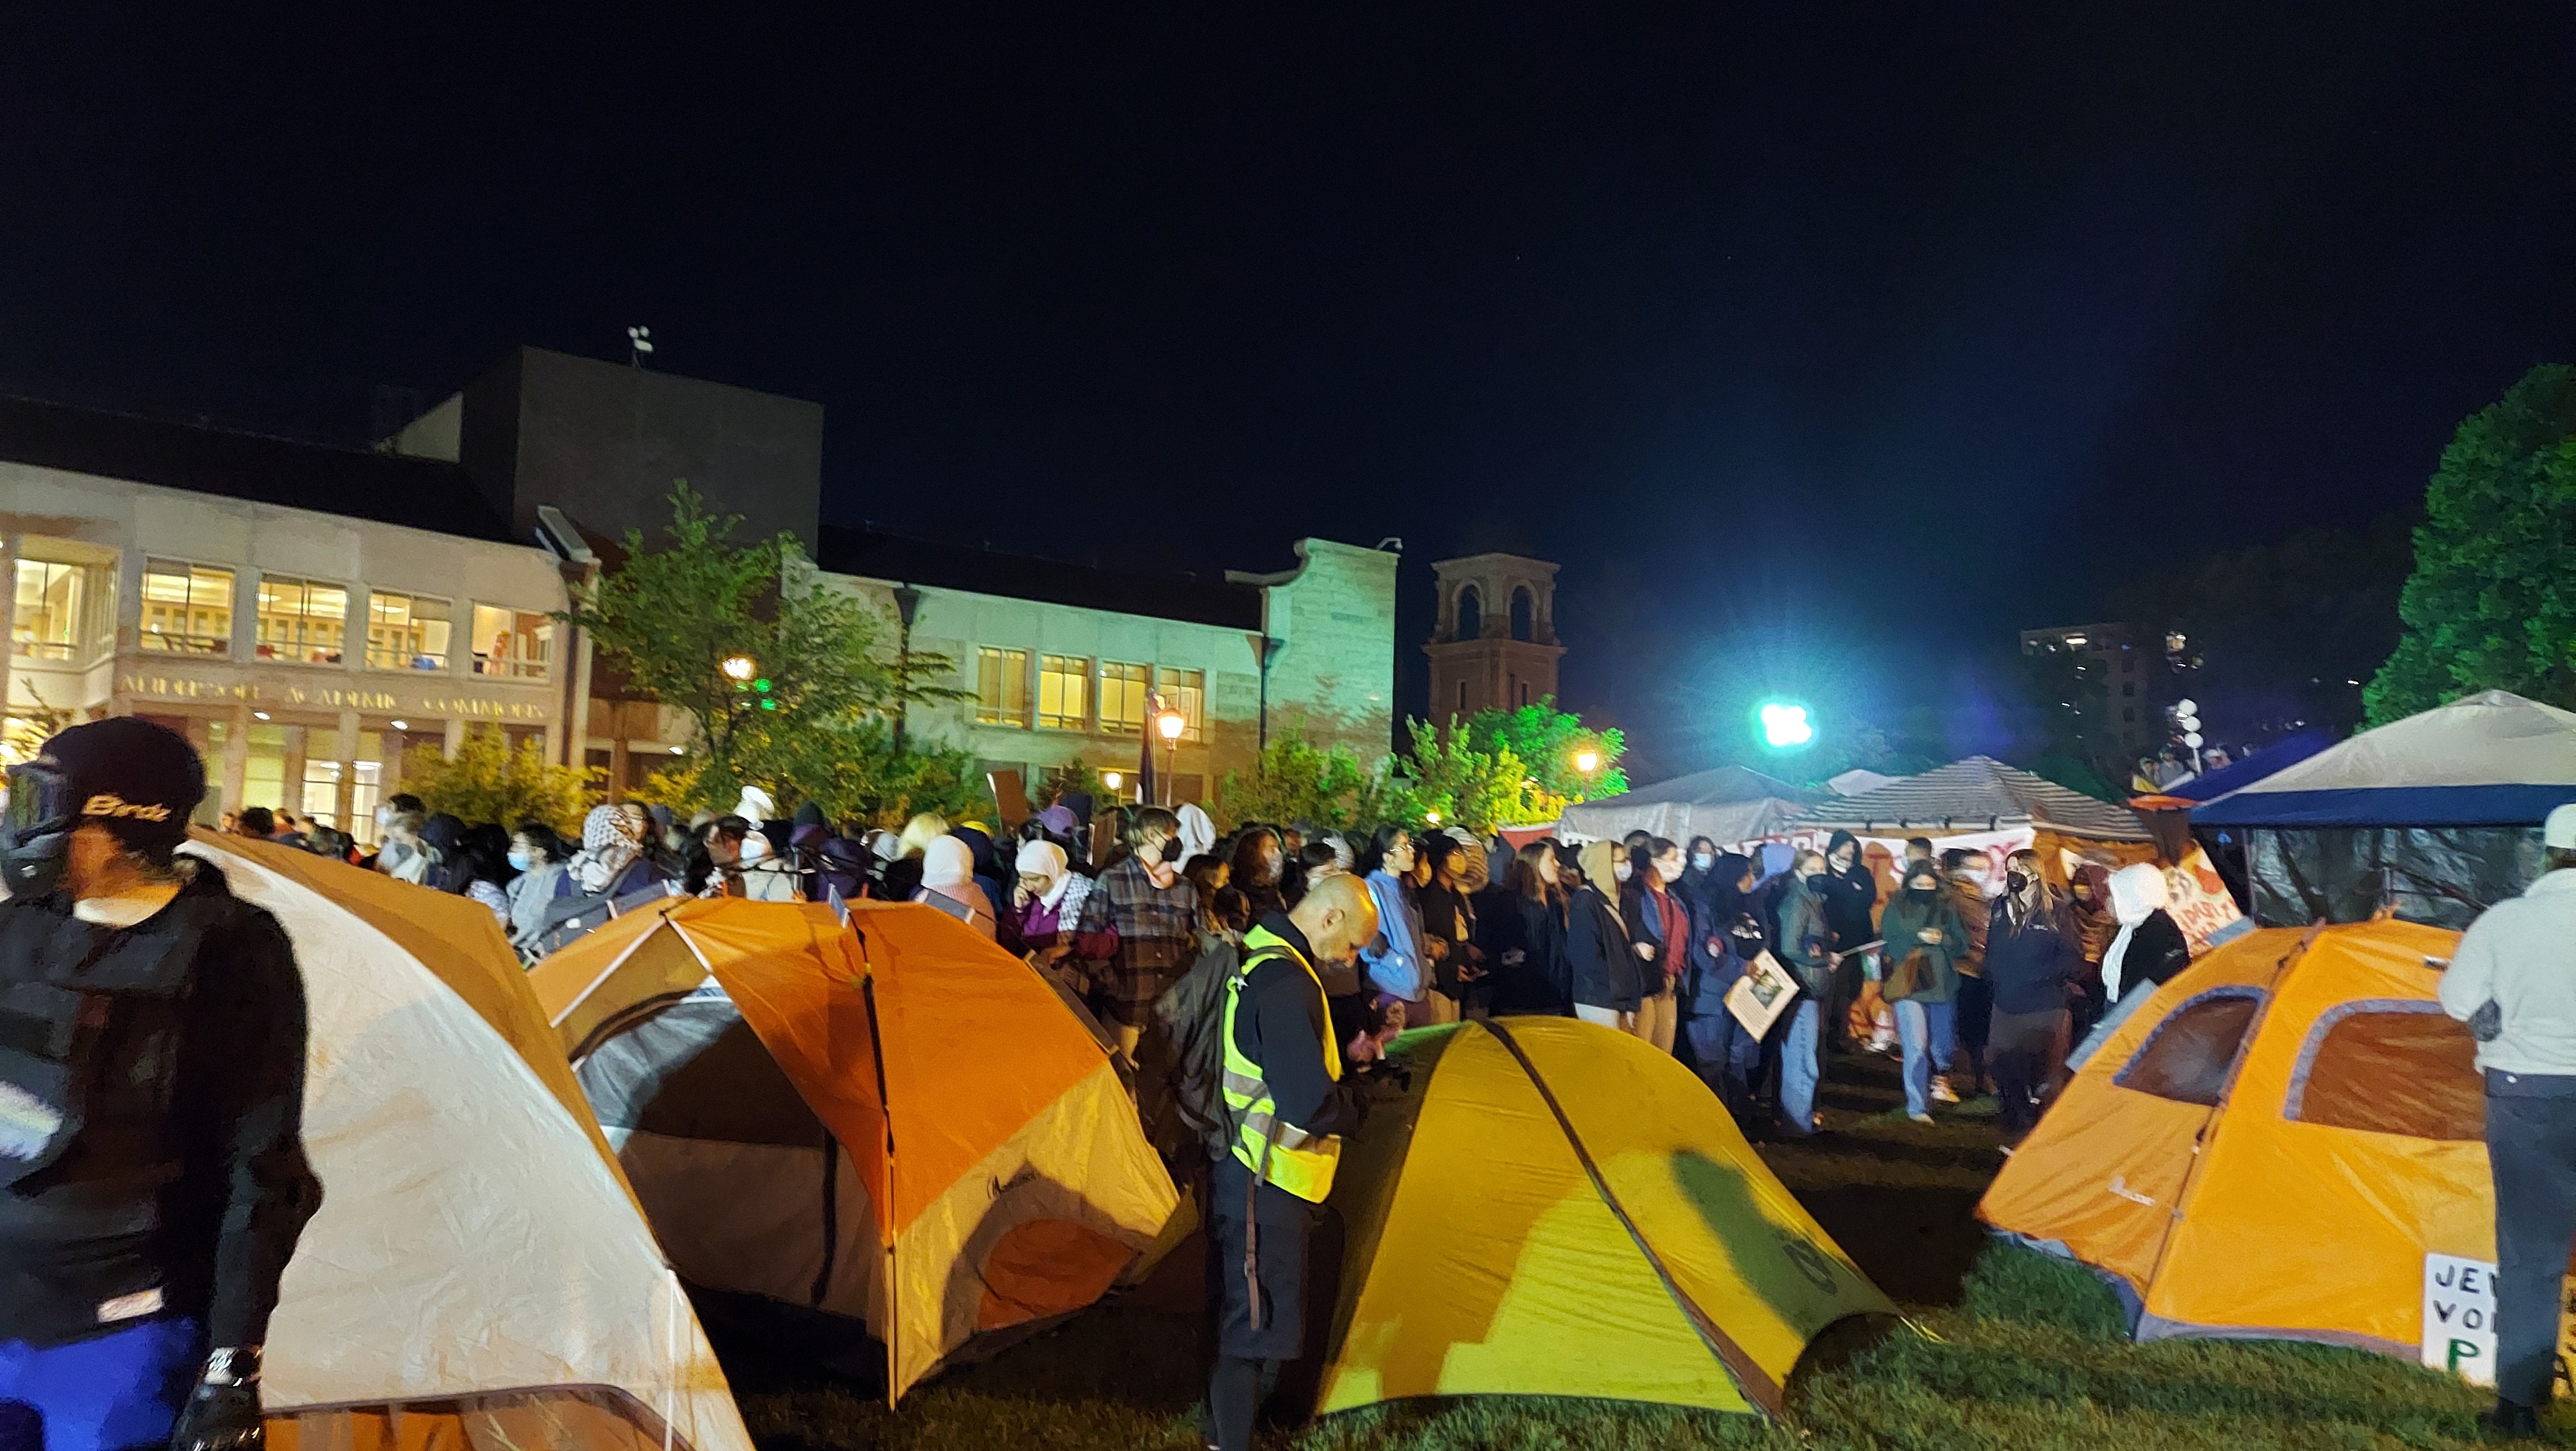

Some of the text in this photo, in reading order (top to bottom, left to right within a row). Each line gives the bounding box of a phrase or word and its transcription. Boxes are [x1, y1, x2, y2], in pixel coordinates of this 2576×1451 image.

[2435, 1264, 2497, 1298] JE
[2433, 1300, 2496, 1332] VO
[2447, 1338, 2496, 1372] P
